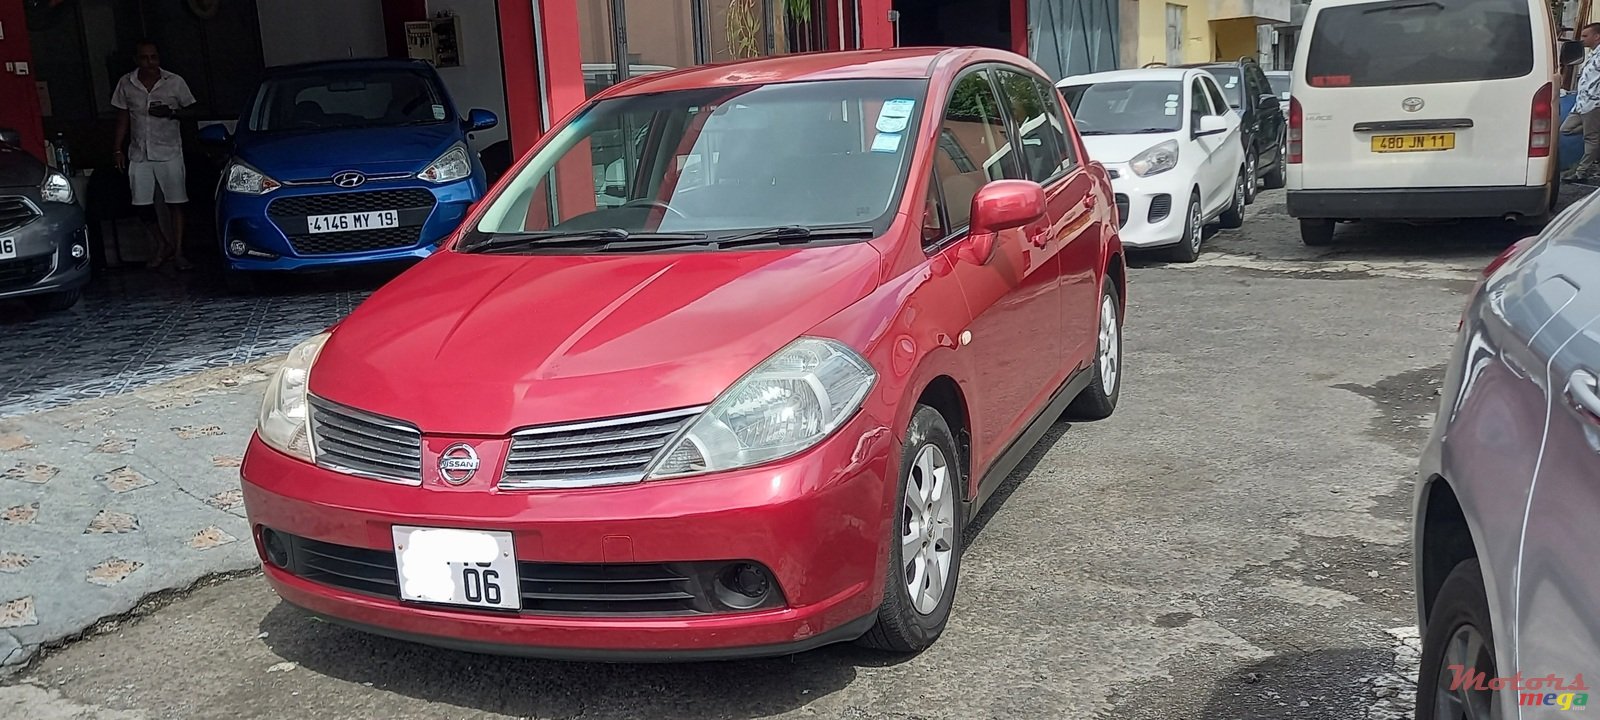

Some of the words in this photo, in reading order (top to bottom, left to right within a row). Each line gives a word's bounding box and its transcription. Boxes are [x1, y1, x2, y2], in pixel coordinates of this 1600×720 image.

[1380, 137, 1404, 149] 480
[1409, 136, 1425, 148] JN
[1431, 135, 1445, 147] 11
[313, 215, 349, 231] 4146
[353, 213, 370, 228] MY
[377, 212, 394, 226] 19
[441, 460, 474, 468] NISSAN
[463, 568, 502, 605] 06
